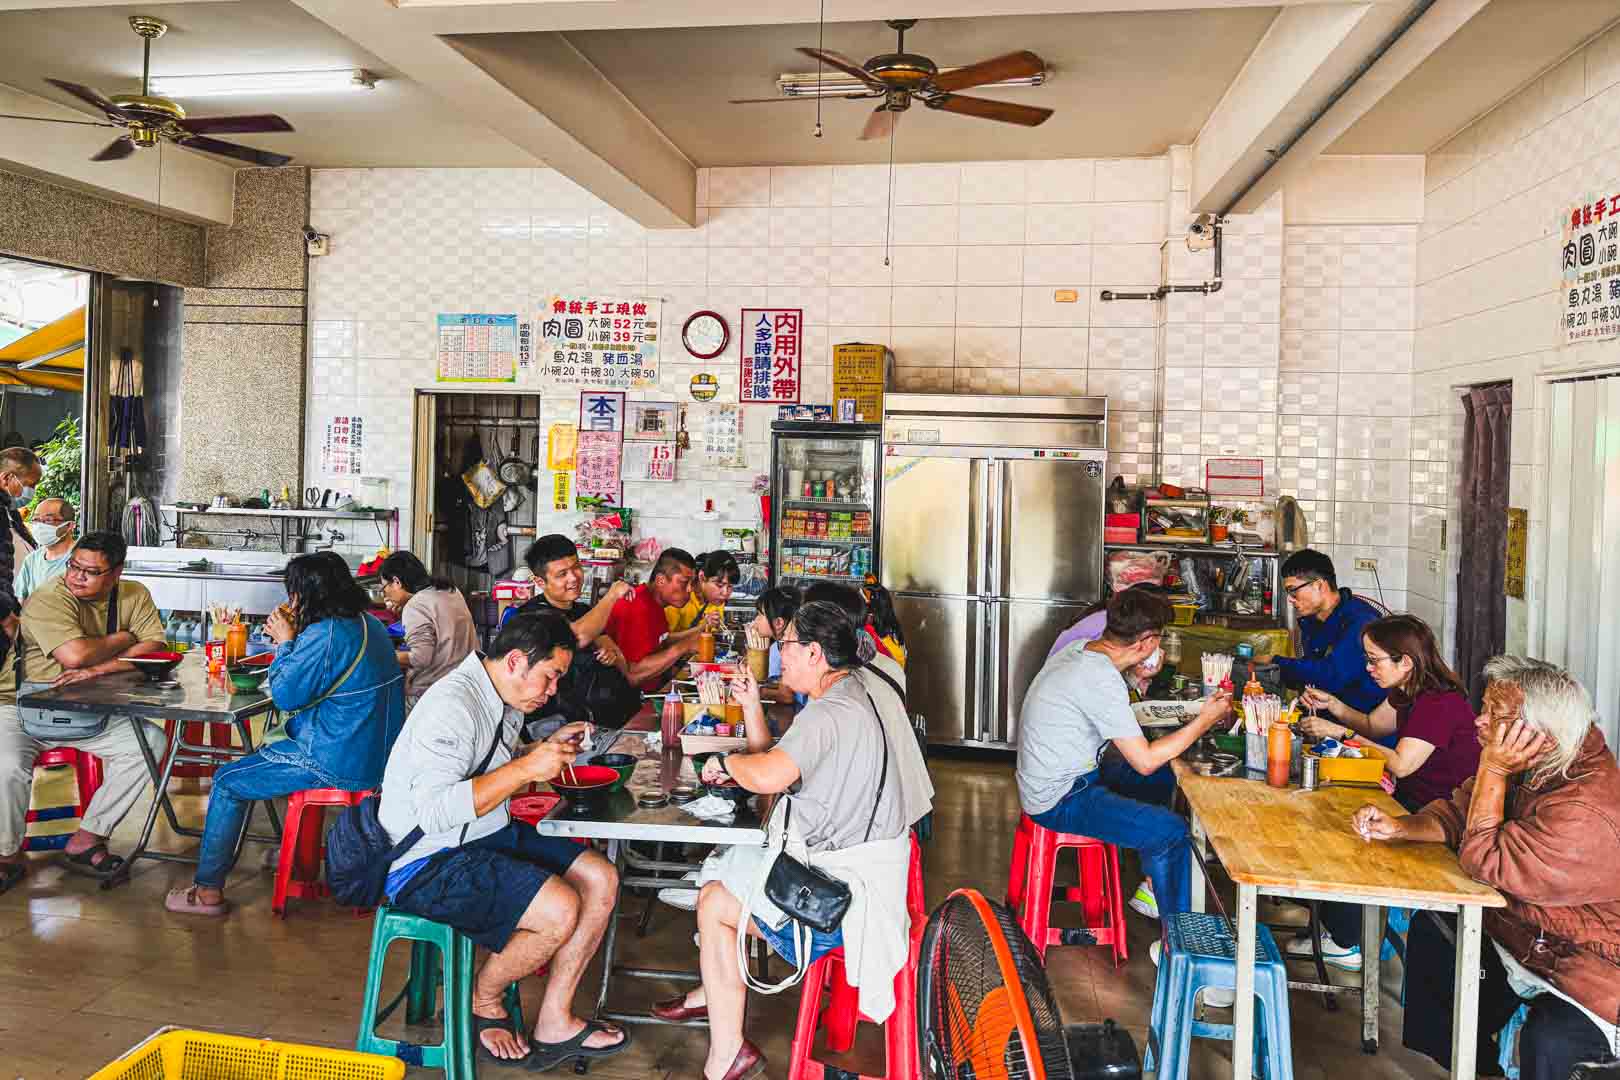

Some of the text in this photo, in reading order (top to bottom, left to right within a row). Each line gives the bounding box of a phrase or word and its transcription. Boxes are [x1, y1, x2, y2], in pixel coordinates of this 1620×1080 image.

[1562, 233, 1595, 273] 肉圓
[1568, 282, 1603, 308] 魚丸湯
[552, 299, 648, 316] 傳統手工現做
[542, 318, 584, 338] 肉圓
[553, 350, 644, 366] 魚丸湯 豬血湯
[753, 312, 773, 399] 人多時請排隊
[773, 312, 798, 400] 內用外帶
[652, 445, 670, 460] 15
